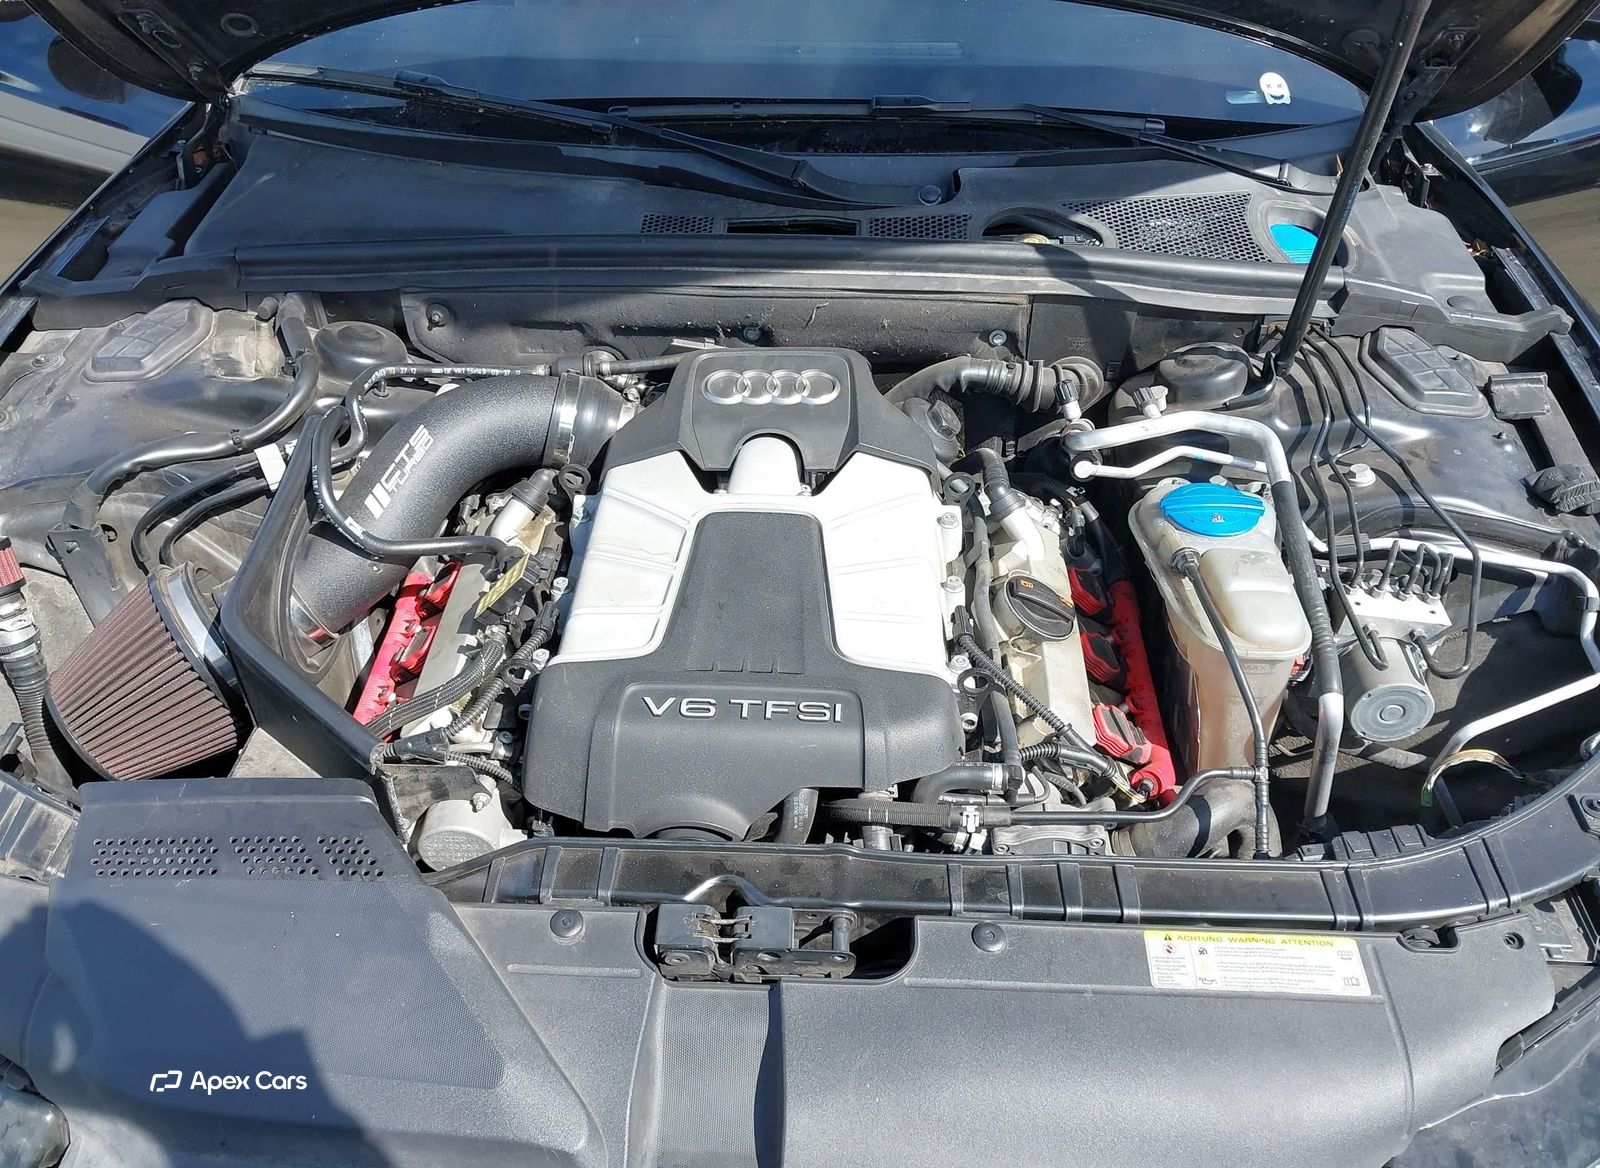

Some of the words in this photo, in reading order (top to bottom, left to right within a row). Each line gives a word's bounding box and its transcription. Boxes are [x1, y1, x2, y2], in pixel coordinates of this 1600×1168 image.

[380, 424, 430, 490] CTS
[387, 434, 435, 493] TURBO
[641, 696, 719, 718] V6
[728, 699, 843, 724] TFSI
[1177, 934, 1223, 943] ACHTUNG
[1228, 937, 1276, 945] WARNING
[1281, 939, 1334, 947] ATTENTION
